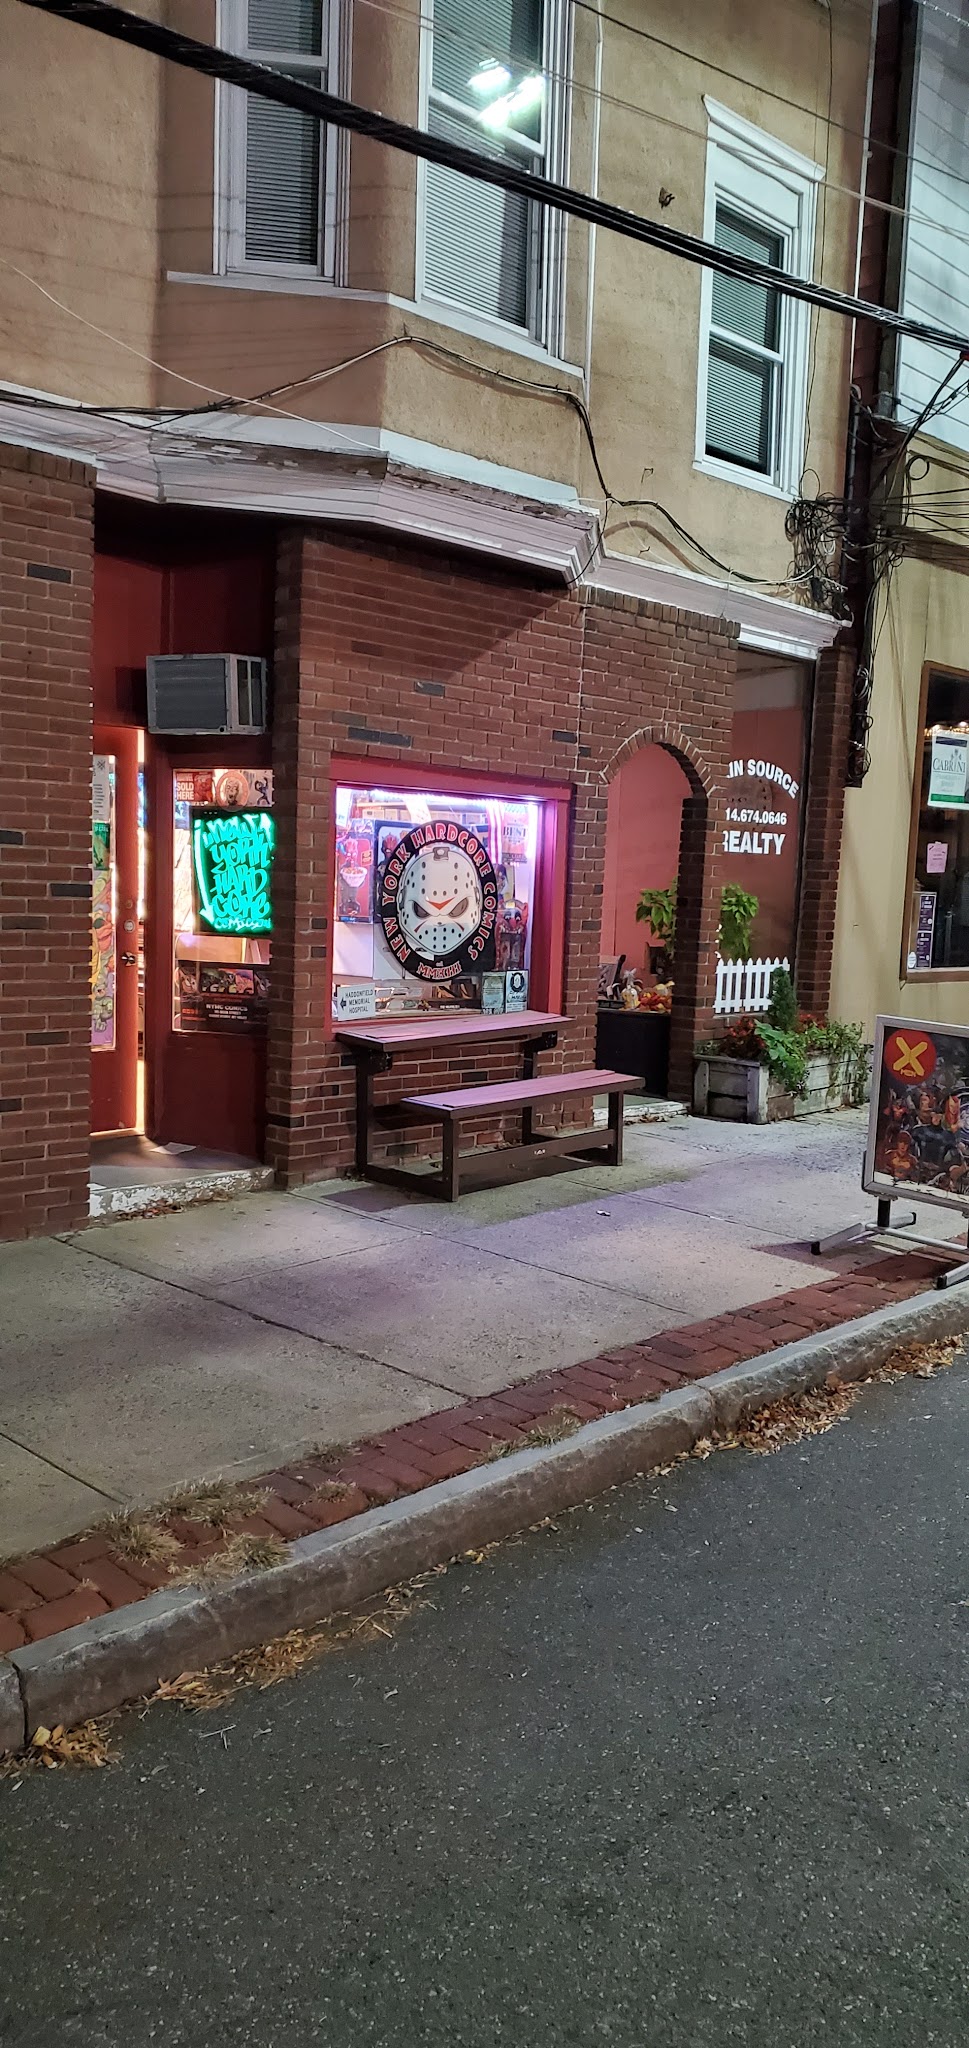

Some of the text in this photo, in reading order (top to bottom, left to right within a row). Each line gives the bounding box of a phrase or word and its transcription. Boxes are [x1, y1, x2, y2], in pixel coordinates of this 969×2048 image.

[933, 757, 966, 773] CABRINI
[177, 782, 194, 792] SOLD
[727, 759, 800, 799] IN SOURCE
[177, 791, 194, 801] HERE
[725, 807, 787, 825] 14.674.0646
[210, 865, 268, 896] HARD
[382, 822, 497, 963] NEW YORK HARDCORE COMICS
[345, 989, 374, 999] HADDONFIELD
[349, 998, 371, 1006] MEMORIAL
[349, 1006, 369, 1014] HOSPITAL
[893, 1036, 928, 1077] X
